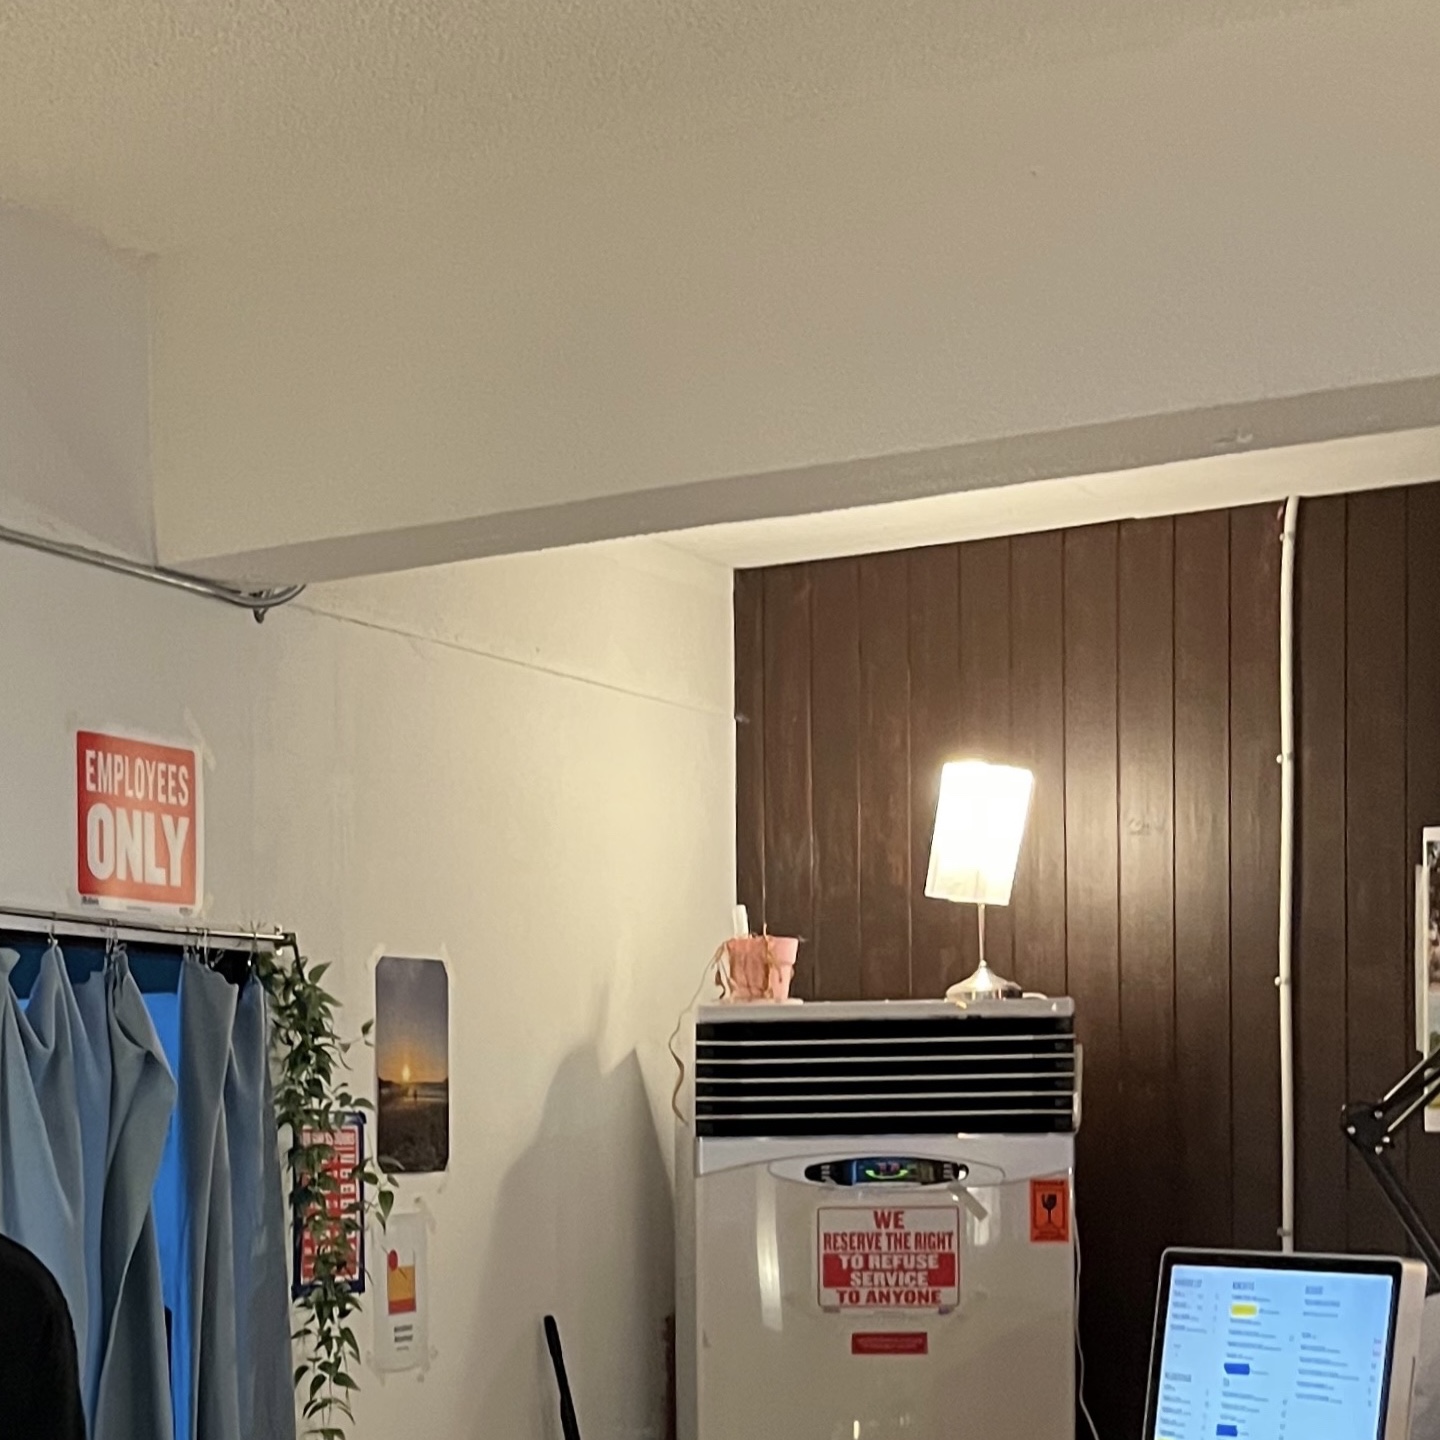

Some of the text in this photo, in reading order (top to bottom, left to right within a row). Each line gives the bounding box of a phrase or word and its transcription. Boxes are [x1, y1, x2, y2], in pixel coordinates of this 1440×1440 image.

[85, 749, 189, 807] EMPLOYEES
[86, 802, 190, 888] ONLY
[873, 1210, 905, 1229] WE
[823, 1231, 954, 1251] RESERVE THE RIGHT
[838, 1254, 939, 1270] TO REFUSE
[850, 1270, 928, 1287] SERVICE
[837, 1289, 942, 1304] TO ANYONE
